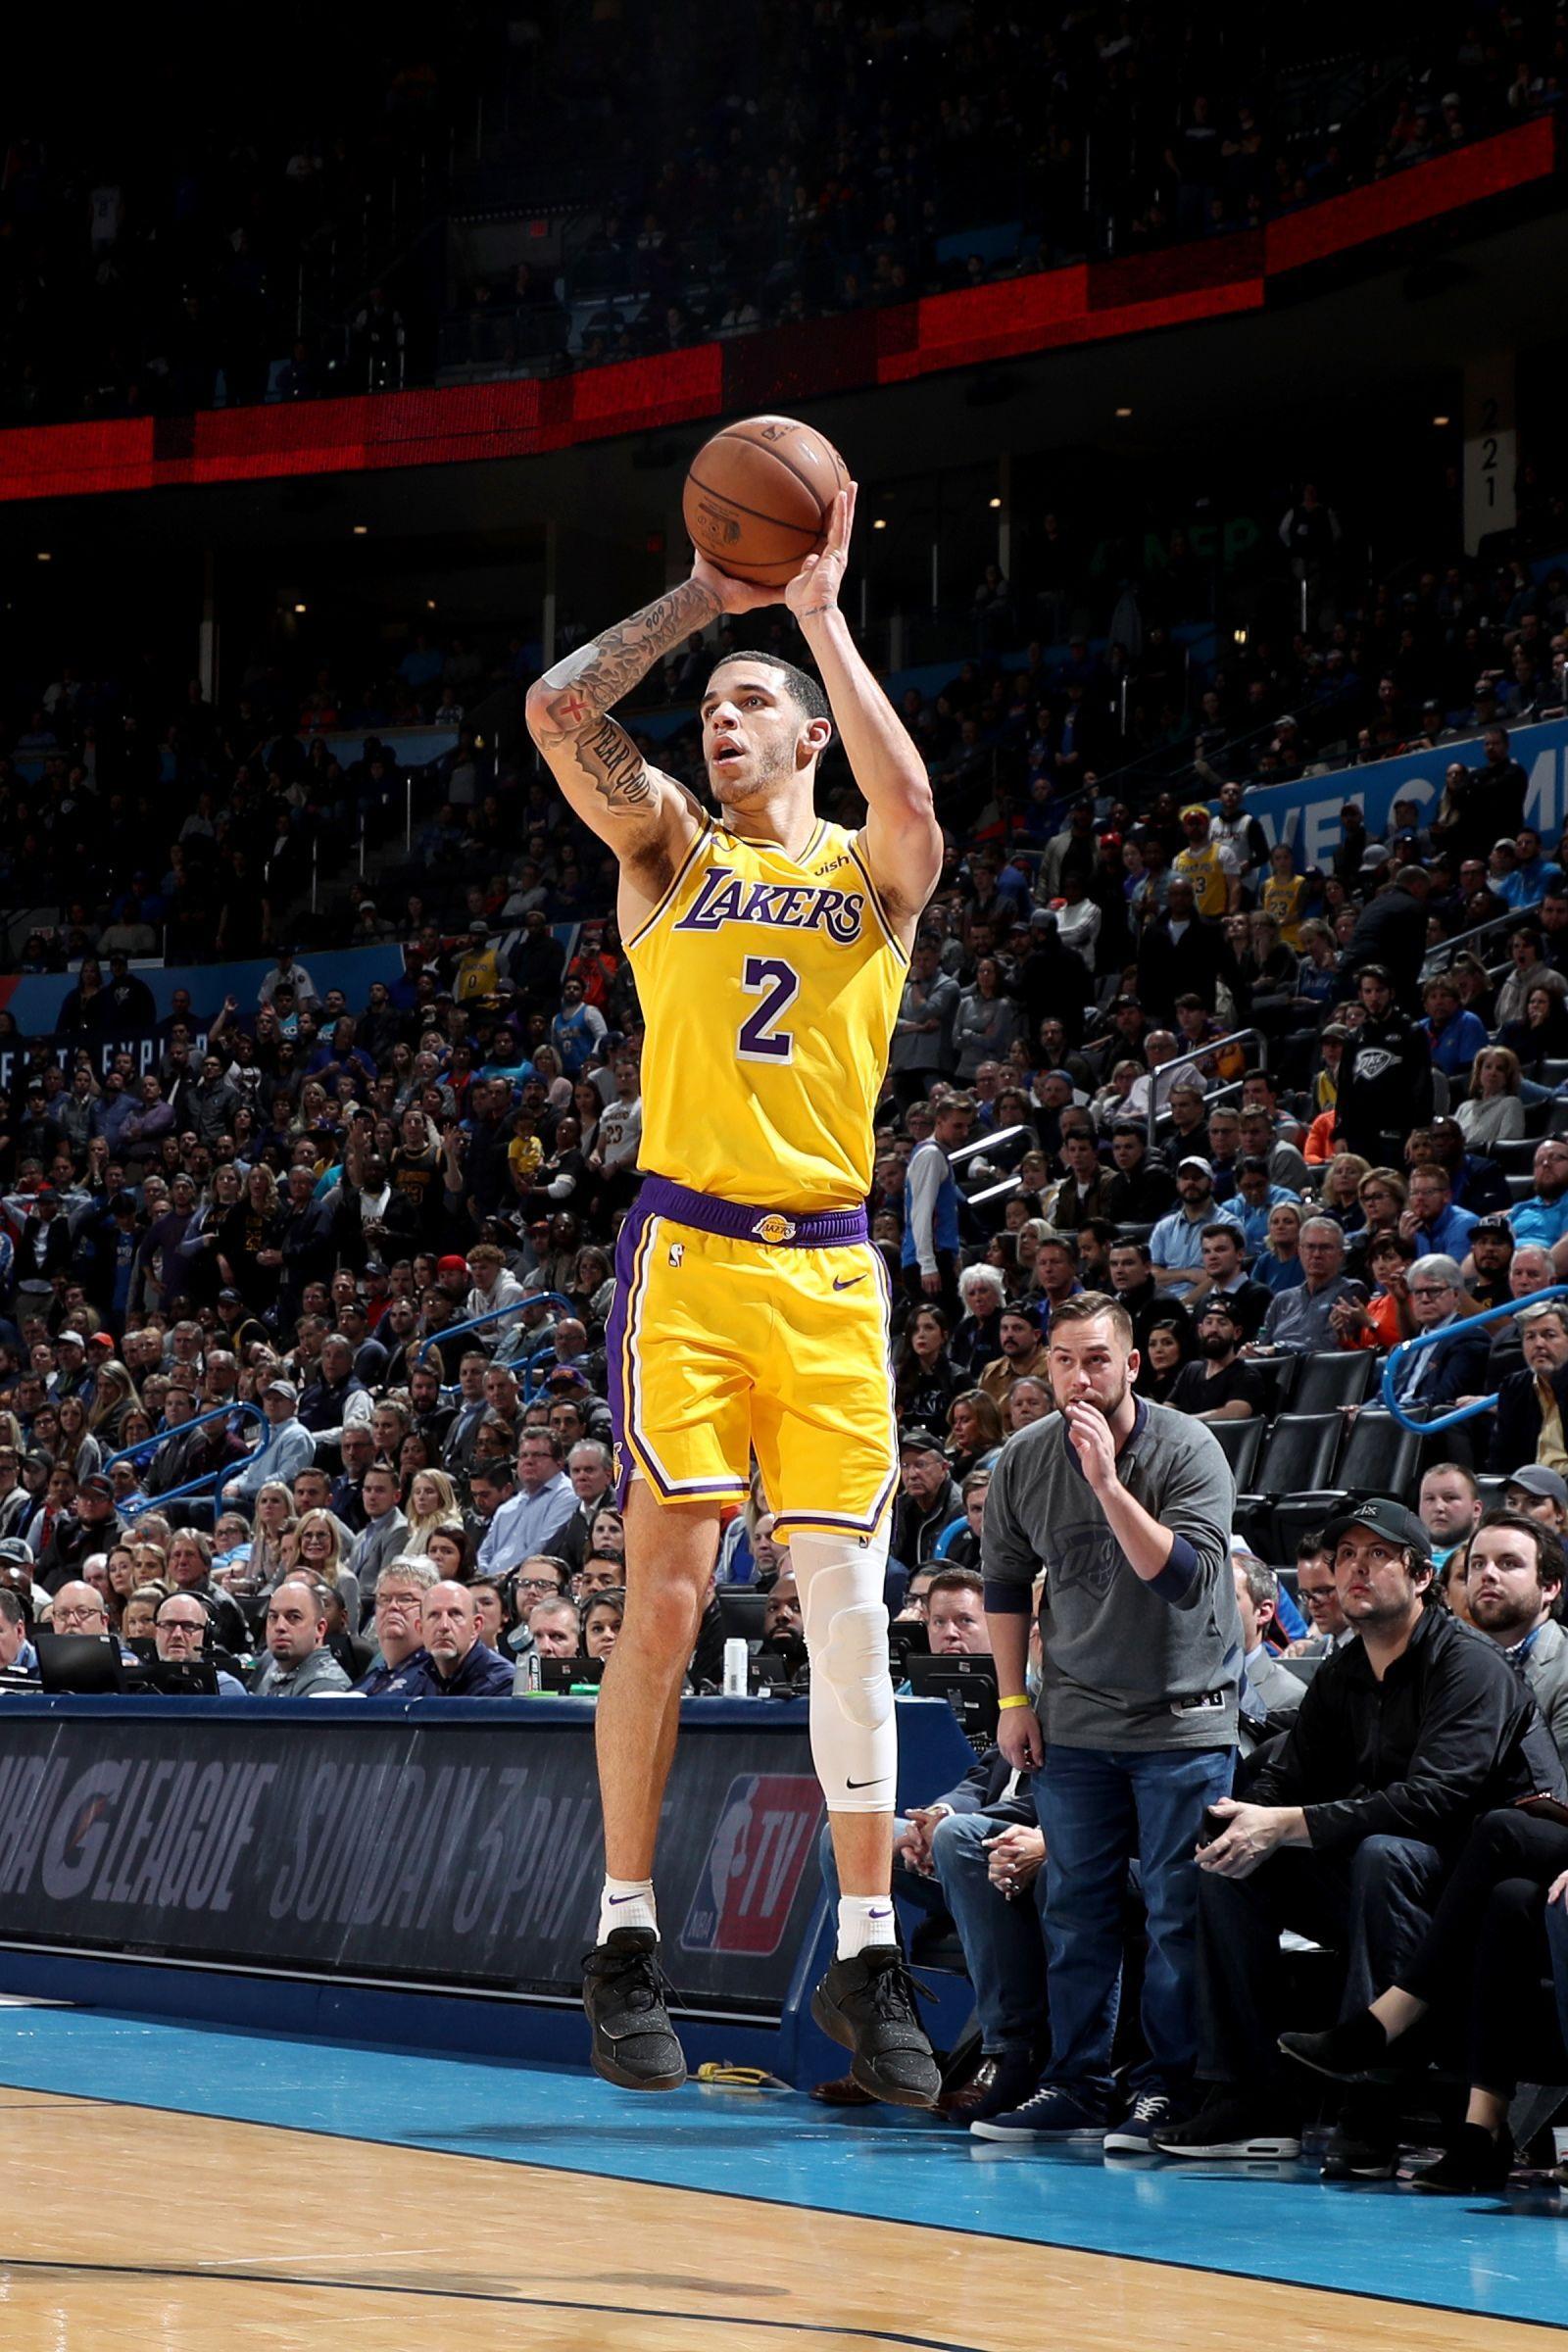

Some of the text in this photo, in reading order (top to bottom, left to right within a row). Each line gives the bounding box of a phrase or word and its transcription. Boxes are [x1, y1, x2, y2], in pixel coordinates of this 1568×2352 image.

[581, 720, 631, 781] FEAR
[672, 867, 866, 946] LAKERS
[736, 954, 802, 1064] 2
[91, 1759, 279, 1912] LEAGUE
[269, 1763, 491, 1930] SUNDAY
[453, 1767, 529, 1935] 3
[738, 1810, 810, 1918] TV
